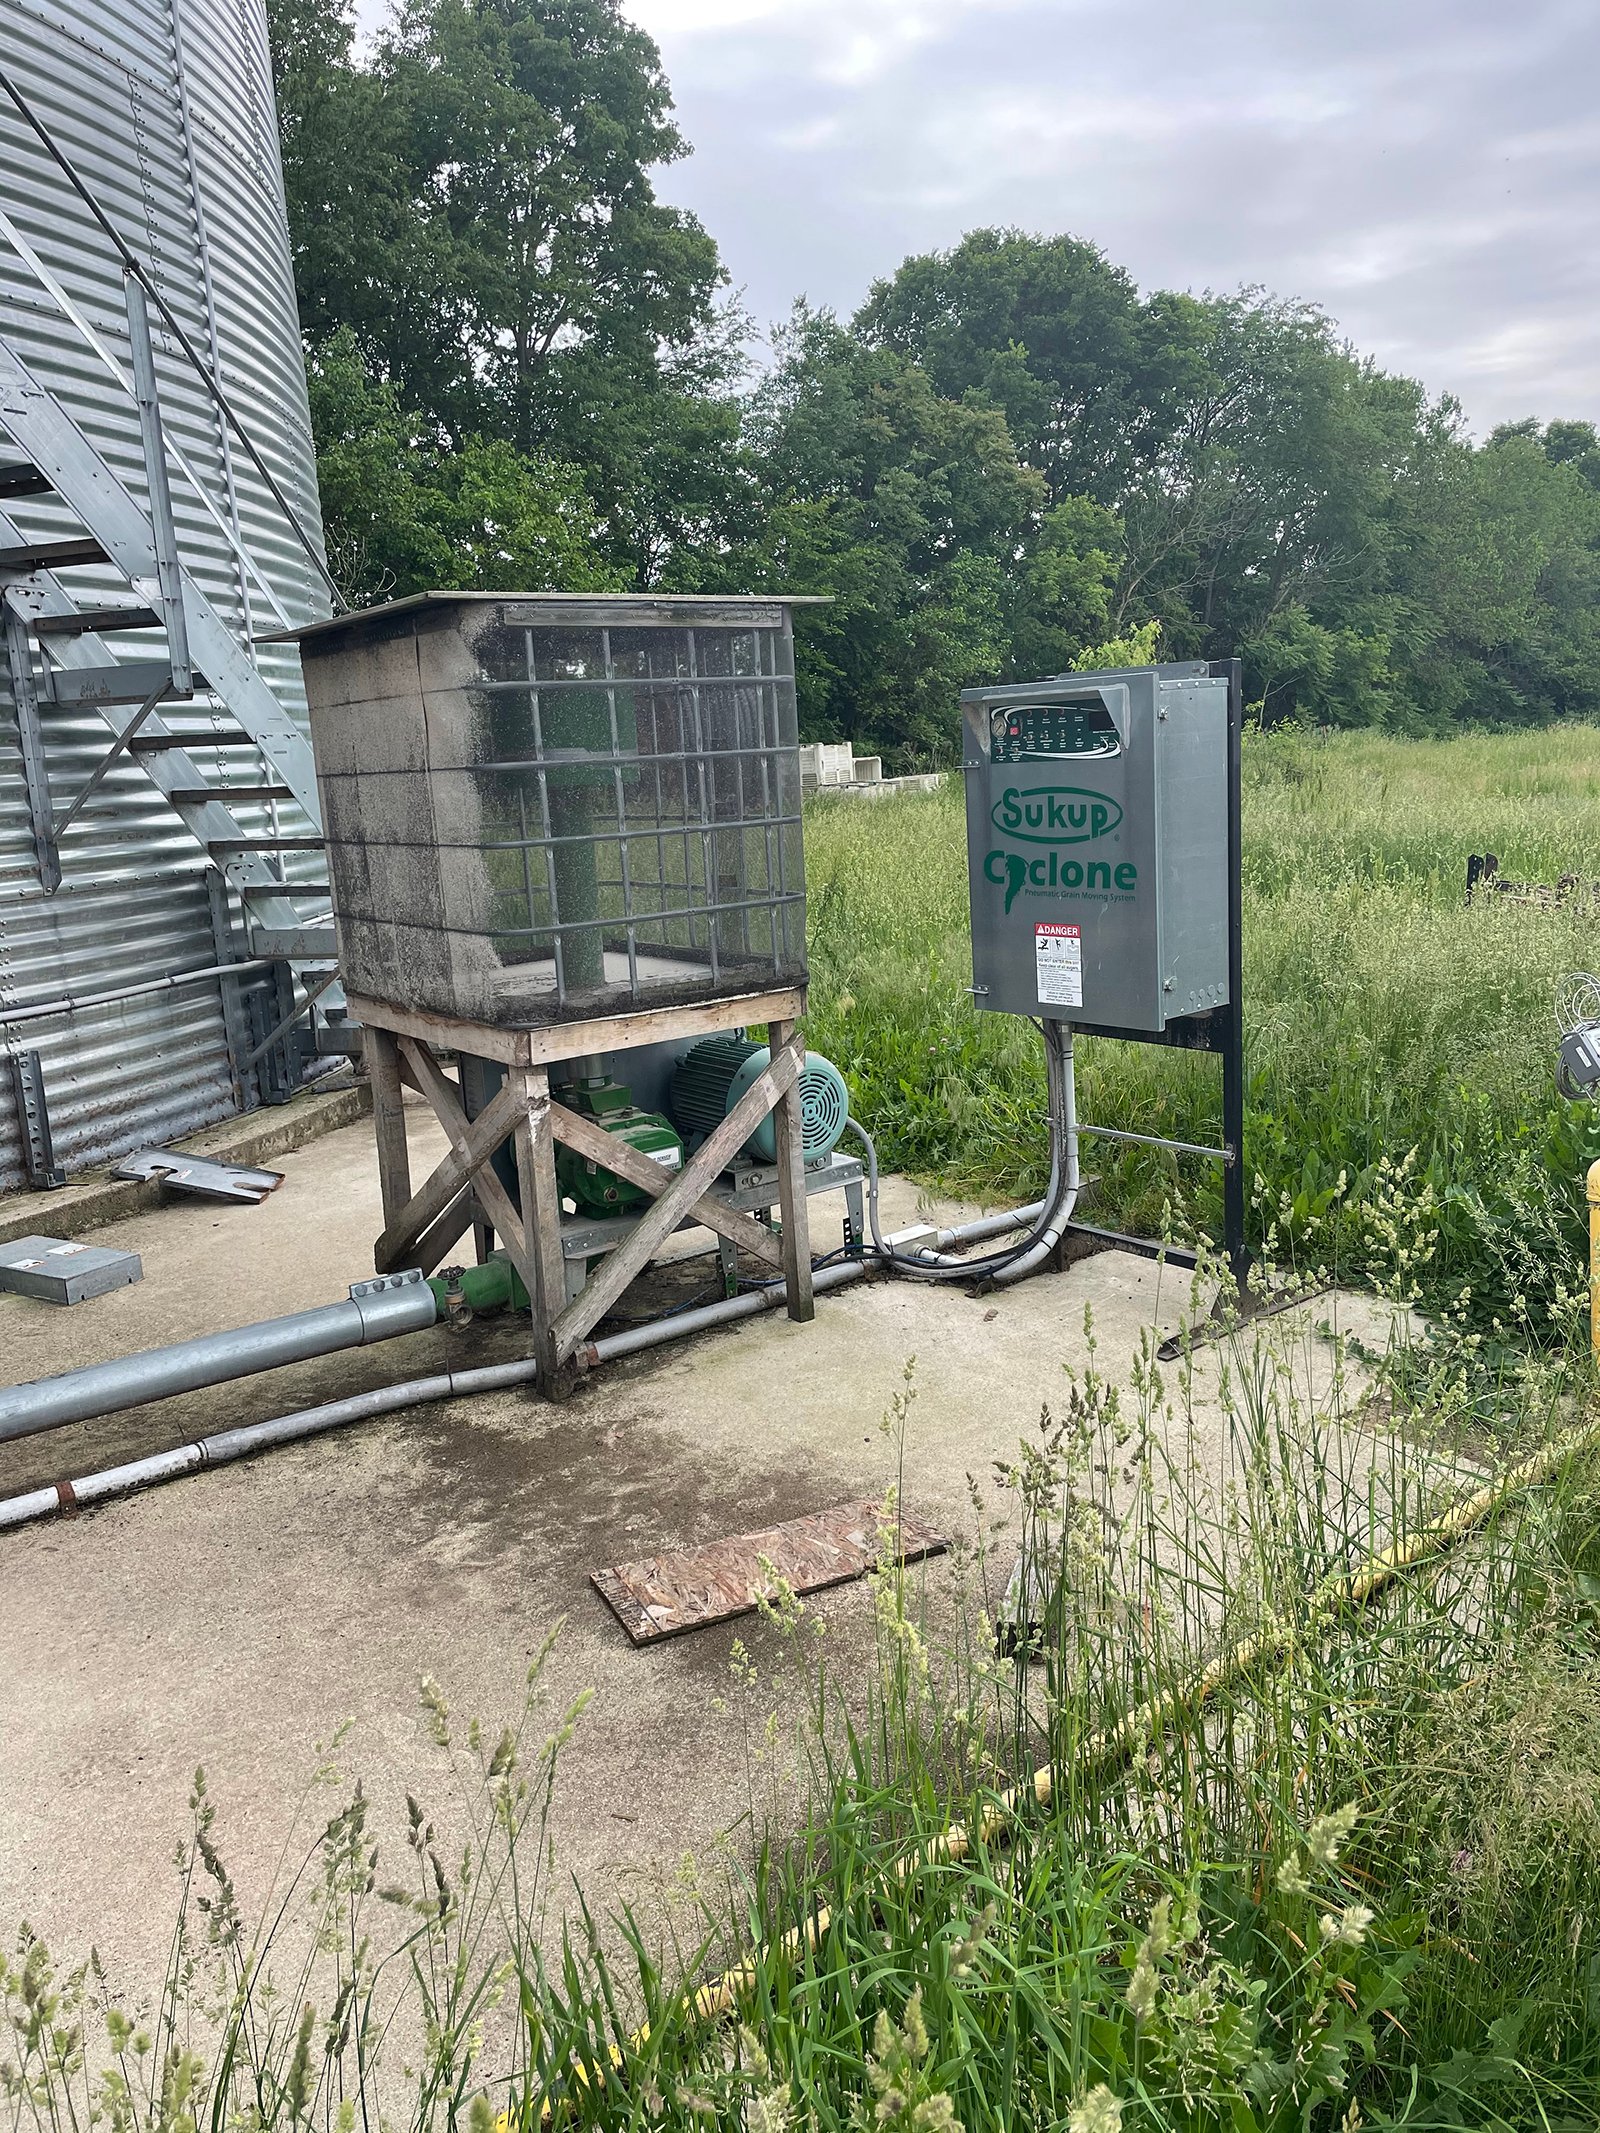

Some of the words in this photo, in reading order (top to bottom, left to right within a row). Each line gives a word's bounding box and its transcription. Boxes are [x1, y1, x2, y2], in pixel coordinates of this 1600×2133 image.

[1002, 787, 1108, 839] Sukup
[1024, 888, 1060, 898] Pneumatic
[1061, 890, 1080, 898] Grain
[1081, 891, 1108, 902] Moving
[1110, 893, 1136, 903] System
[1044, 926, 1078, 936] DANGER
